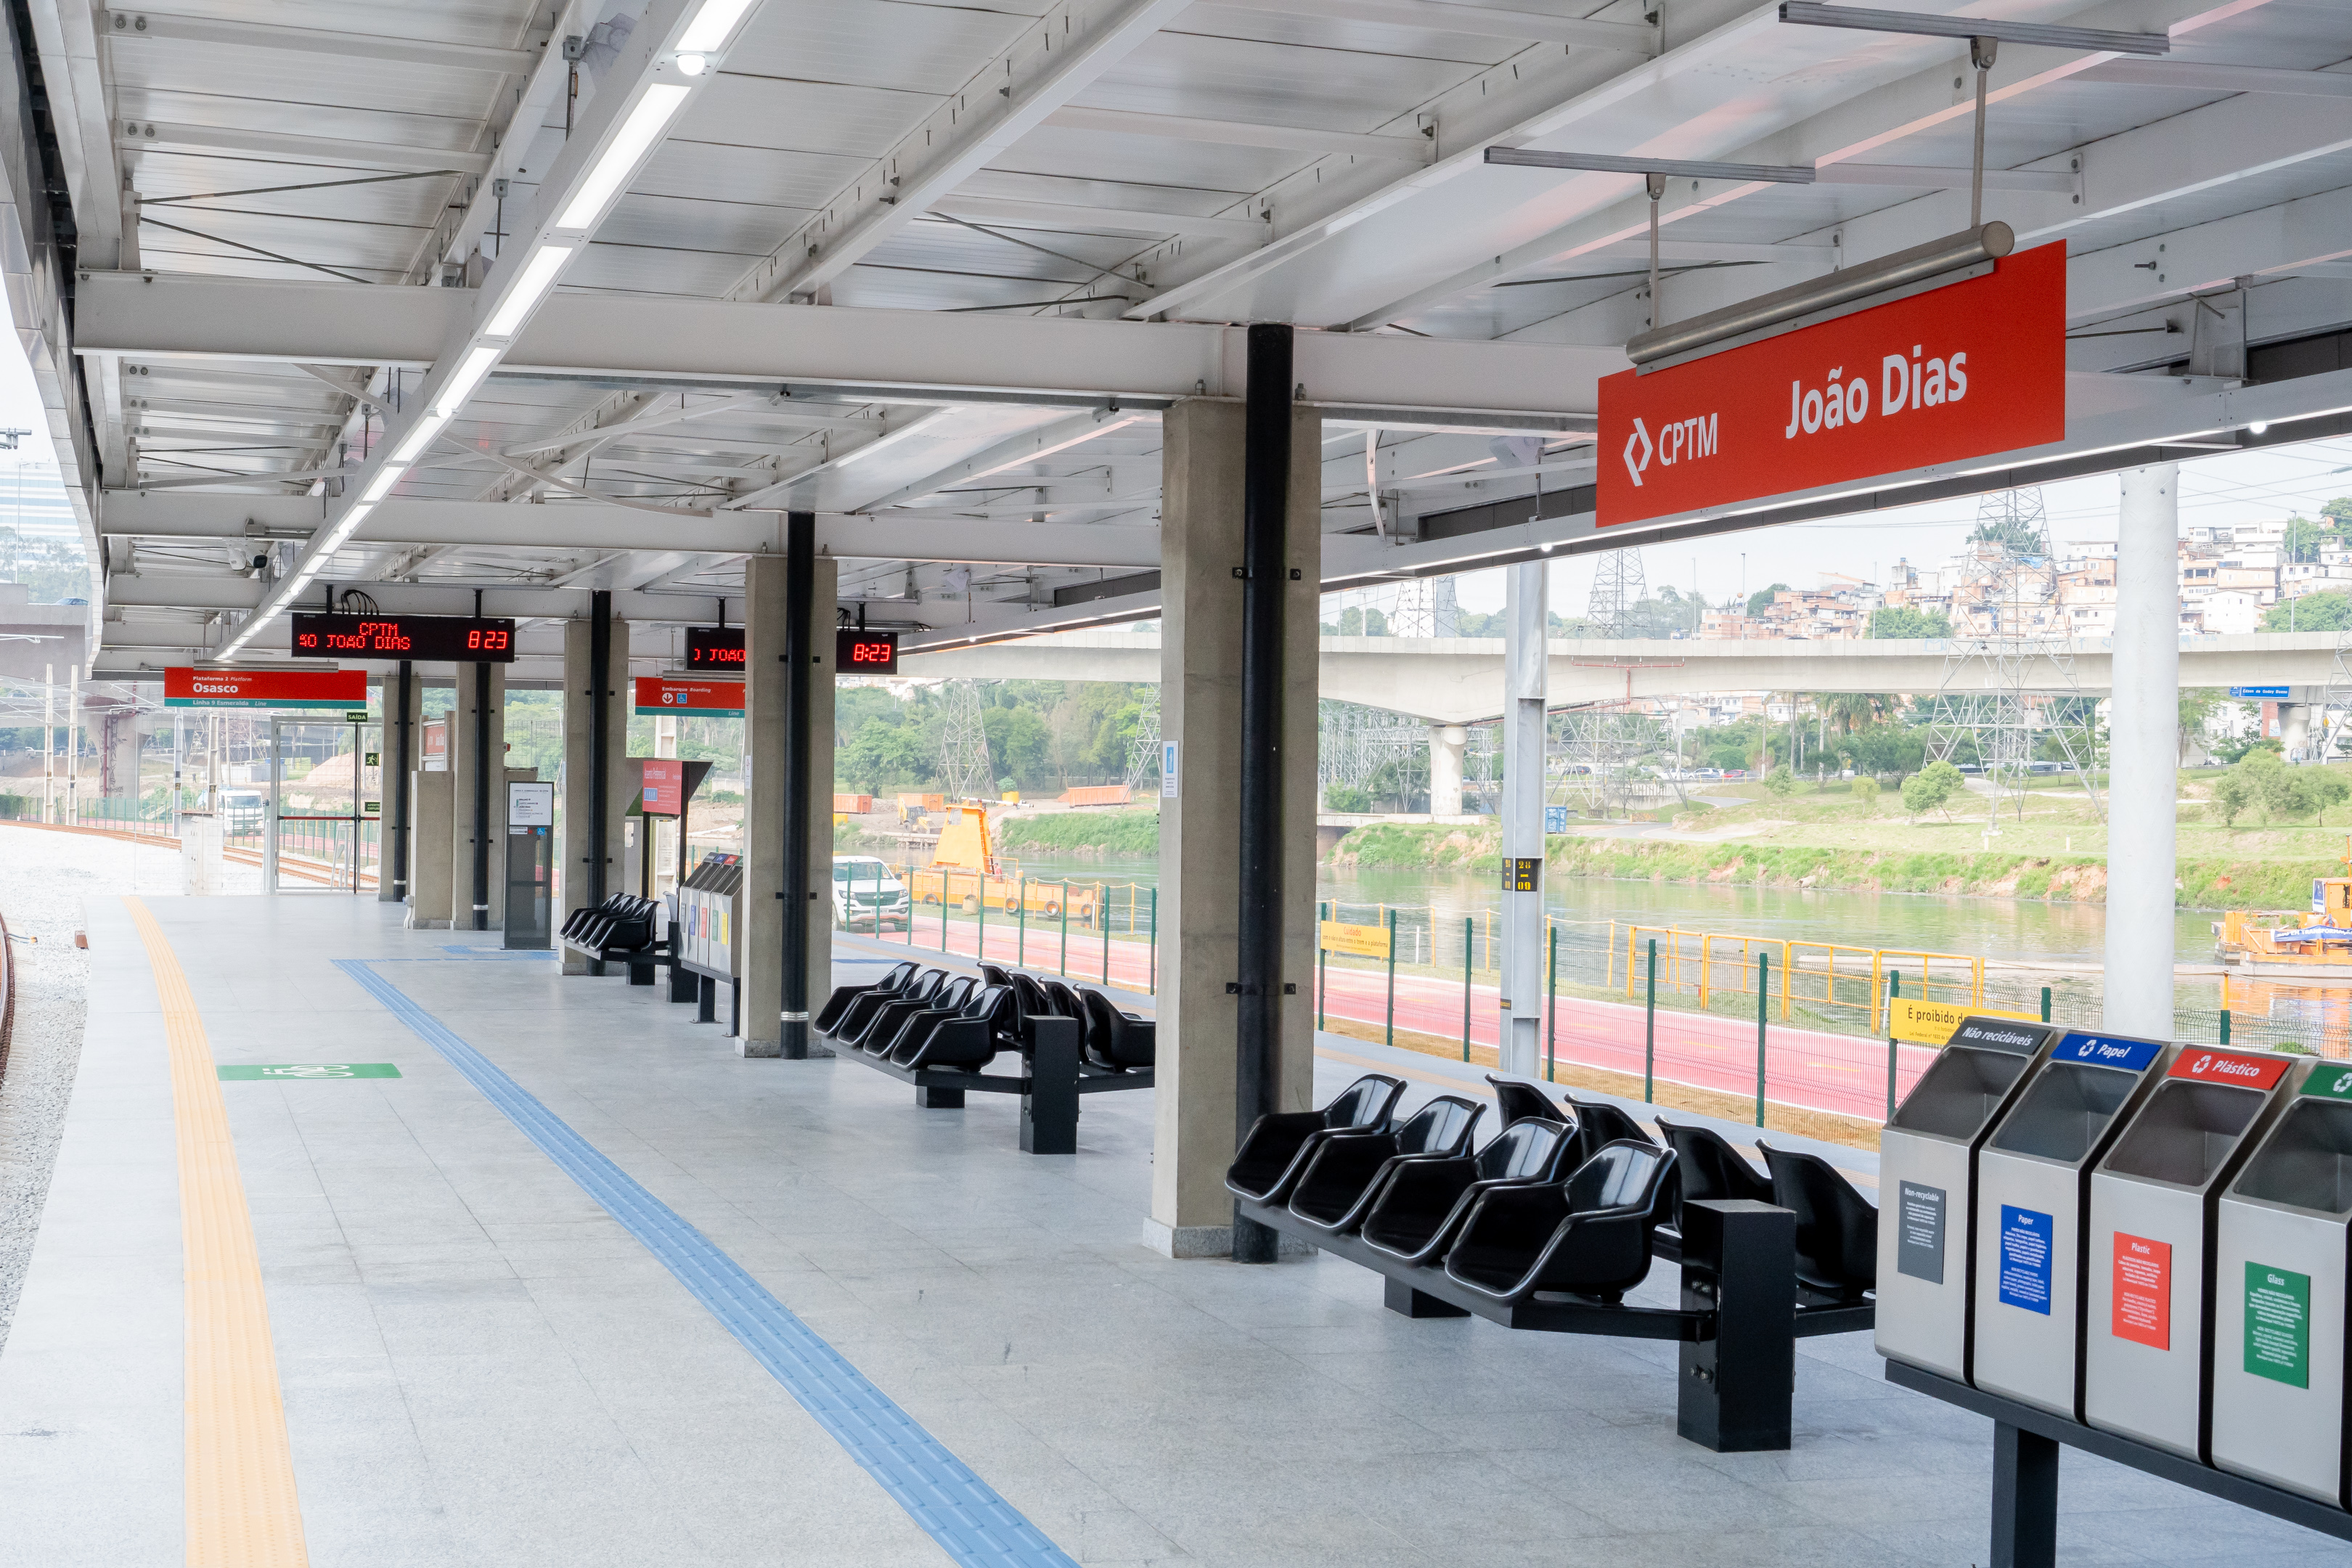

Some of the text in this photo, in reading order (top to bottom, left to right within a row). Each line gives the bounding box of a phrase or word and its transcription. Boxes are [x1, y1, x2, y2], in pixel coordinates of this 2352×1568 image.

[1786, 344, 1968, 438] João Dias
[1659, 412, 1718, 465] CPTM
[359, 622, 399, 637] CPTM
[375, 636, 411, 651] DIAS
[854, 643, 891, 662] 8:23
[192, 682, 238, 693] Osasco
[1518, 861, 1531, 869] 28
[1517, 881, 1531, 890] 09
[1343, 926, 1362, 936] Cuidado
[1908, 1004, 1913, 1019] É
[1916, 1009, 1955, 1024] proibido
[1962, 1026, 2034, 1046] Não recicláveis
[2096, 1044, 2132, 1060] Papel
[2212, 1058, 2261, 1077] Plástico
[1904, 1187, 1939, 1202] Non-recyclable
[2018, 1214, 2034, 1225] Paper
[2131, 1242, 2151, 1254] Plastic
[2267, 1273, 2285, 1286] Glass
